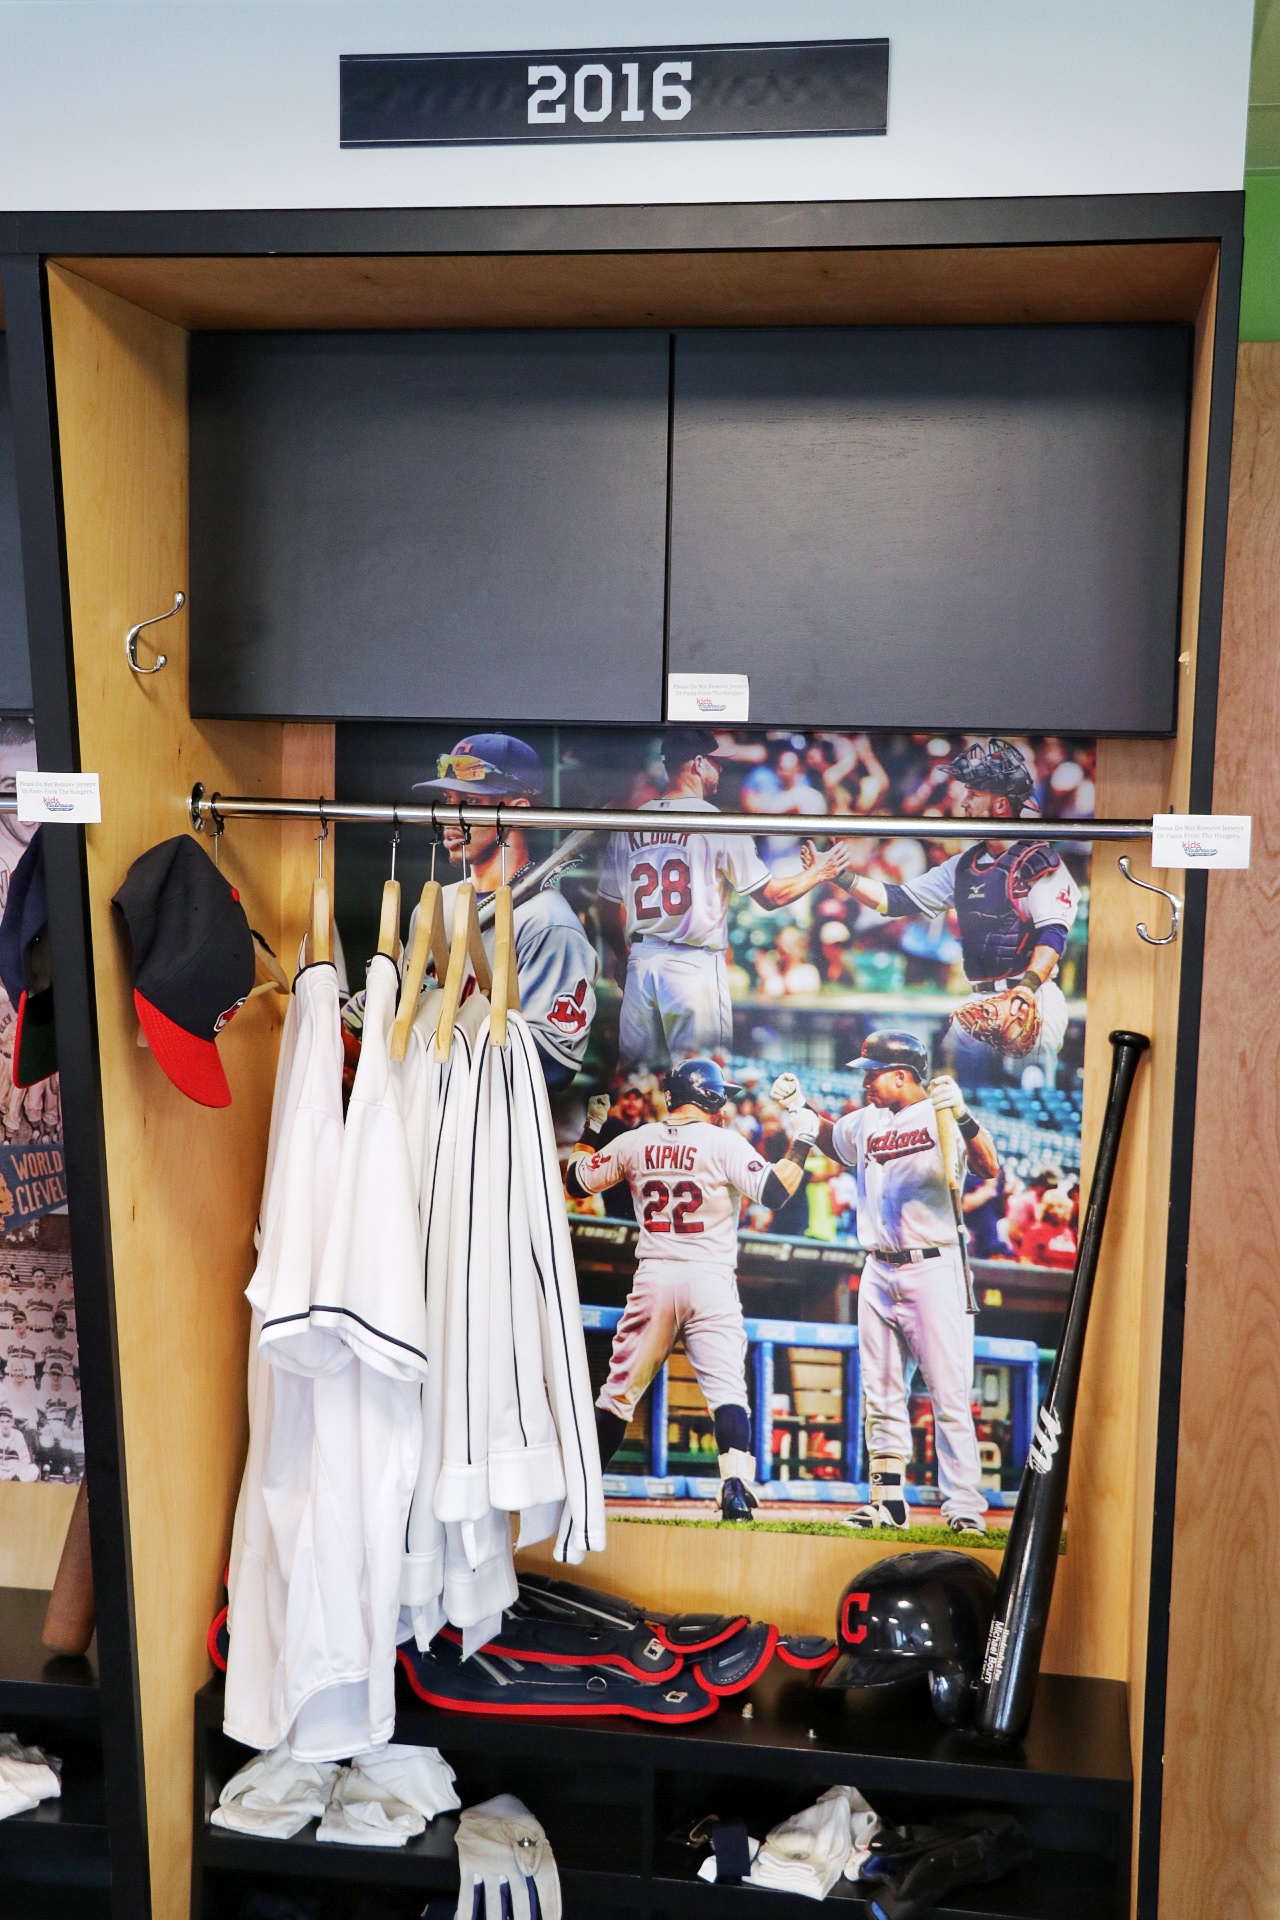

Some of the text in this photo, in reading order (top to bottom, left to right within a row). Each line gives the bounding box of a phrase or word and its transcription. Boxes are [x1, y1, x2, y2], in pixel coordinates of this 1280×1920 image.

[527, 61, 692, 124] 2016
[1181, 841, 1201, 849] kids
[631, 858, 692, 920] 28
[10, 1150, 63, 1181] WORLD
[644, 1145, 698, 1171] KIPNIS
[642, 1180, 704, 1234] 22
[841, 1592, 870, 1644] C
[989, 1620, 1005, 1656] Michael
